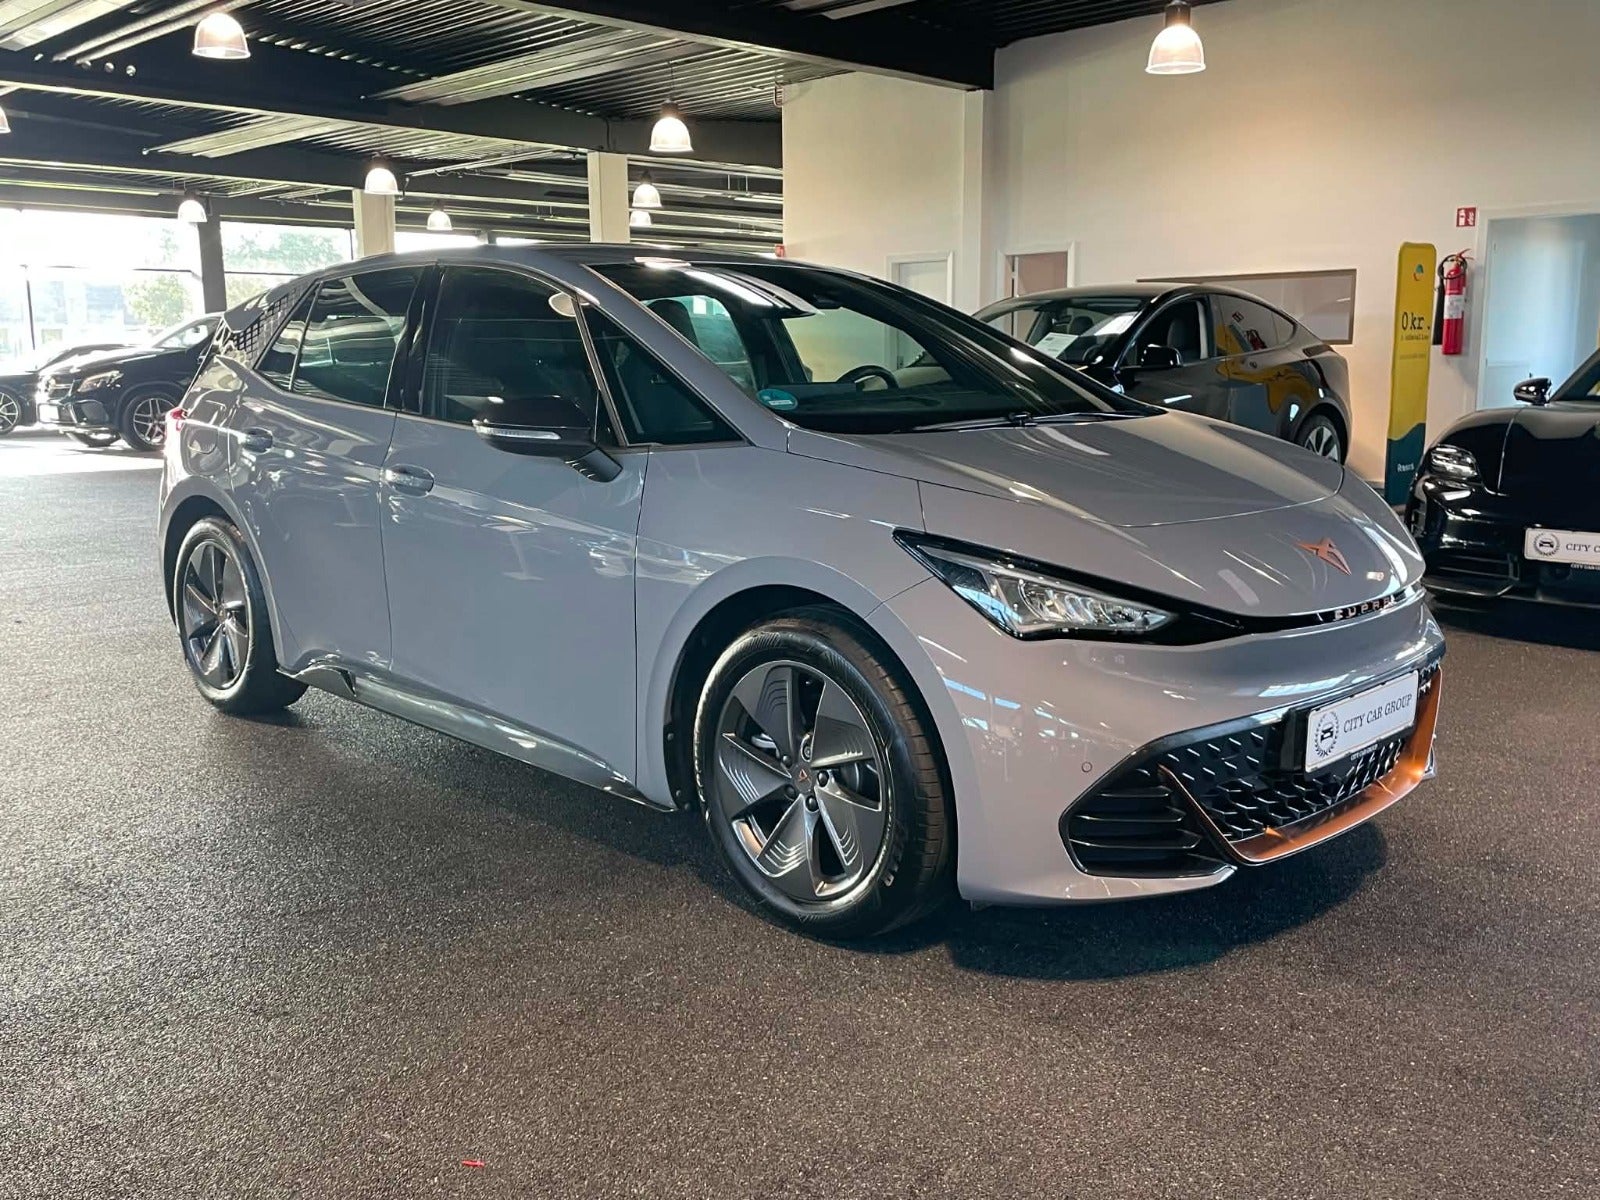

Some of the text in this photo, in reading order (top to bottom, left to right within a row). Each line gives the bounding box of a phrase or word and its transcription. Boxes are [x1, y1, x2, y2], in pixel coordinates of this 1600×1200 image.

[1410, 312, 1431, 331] kr.
[1566, 543, 1591, 552] CITY
[1343, 693, 1413, 734] CITY CAR GROUP
